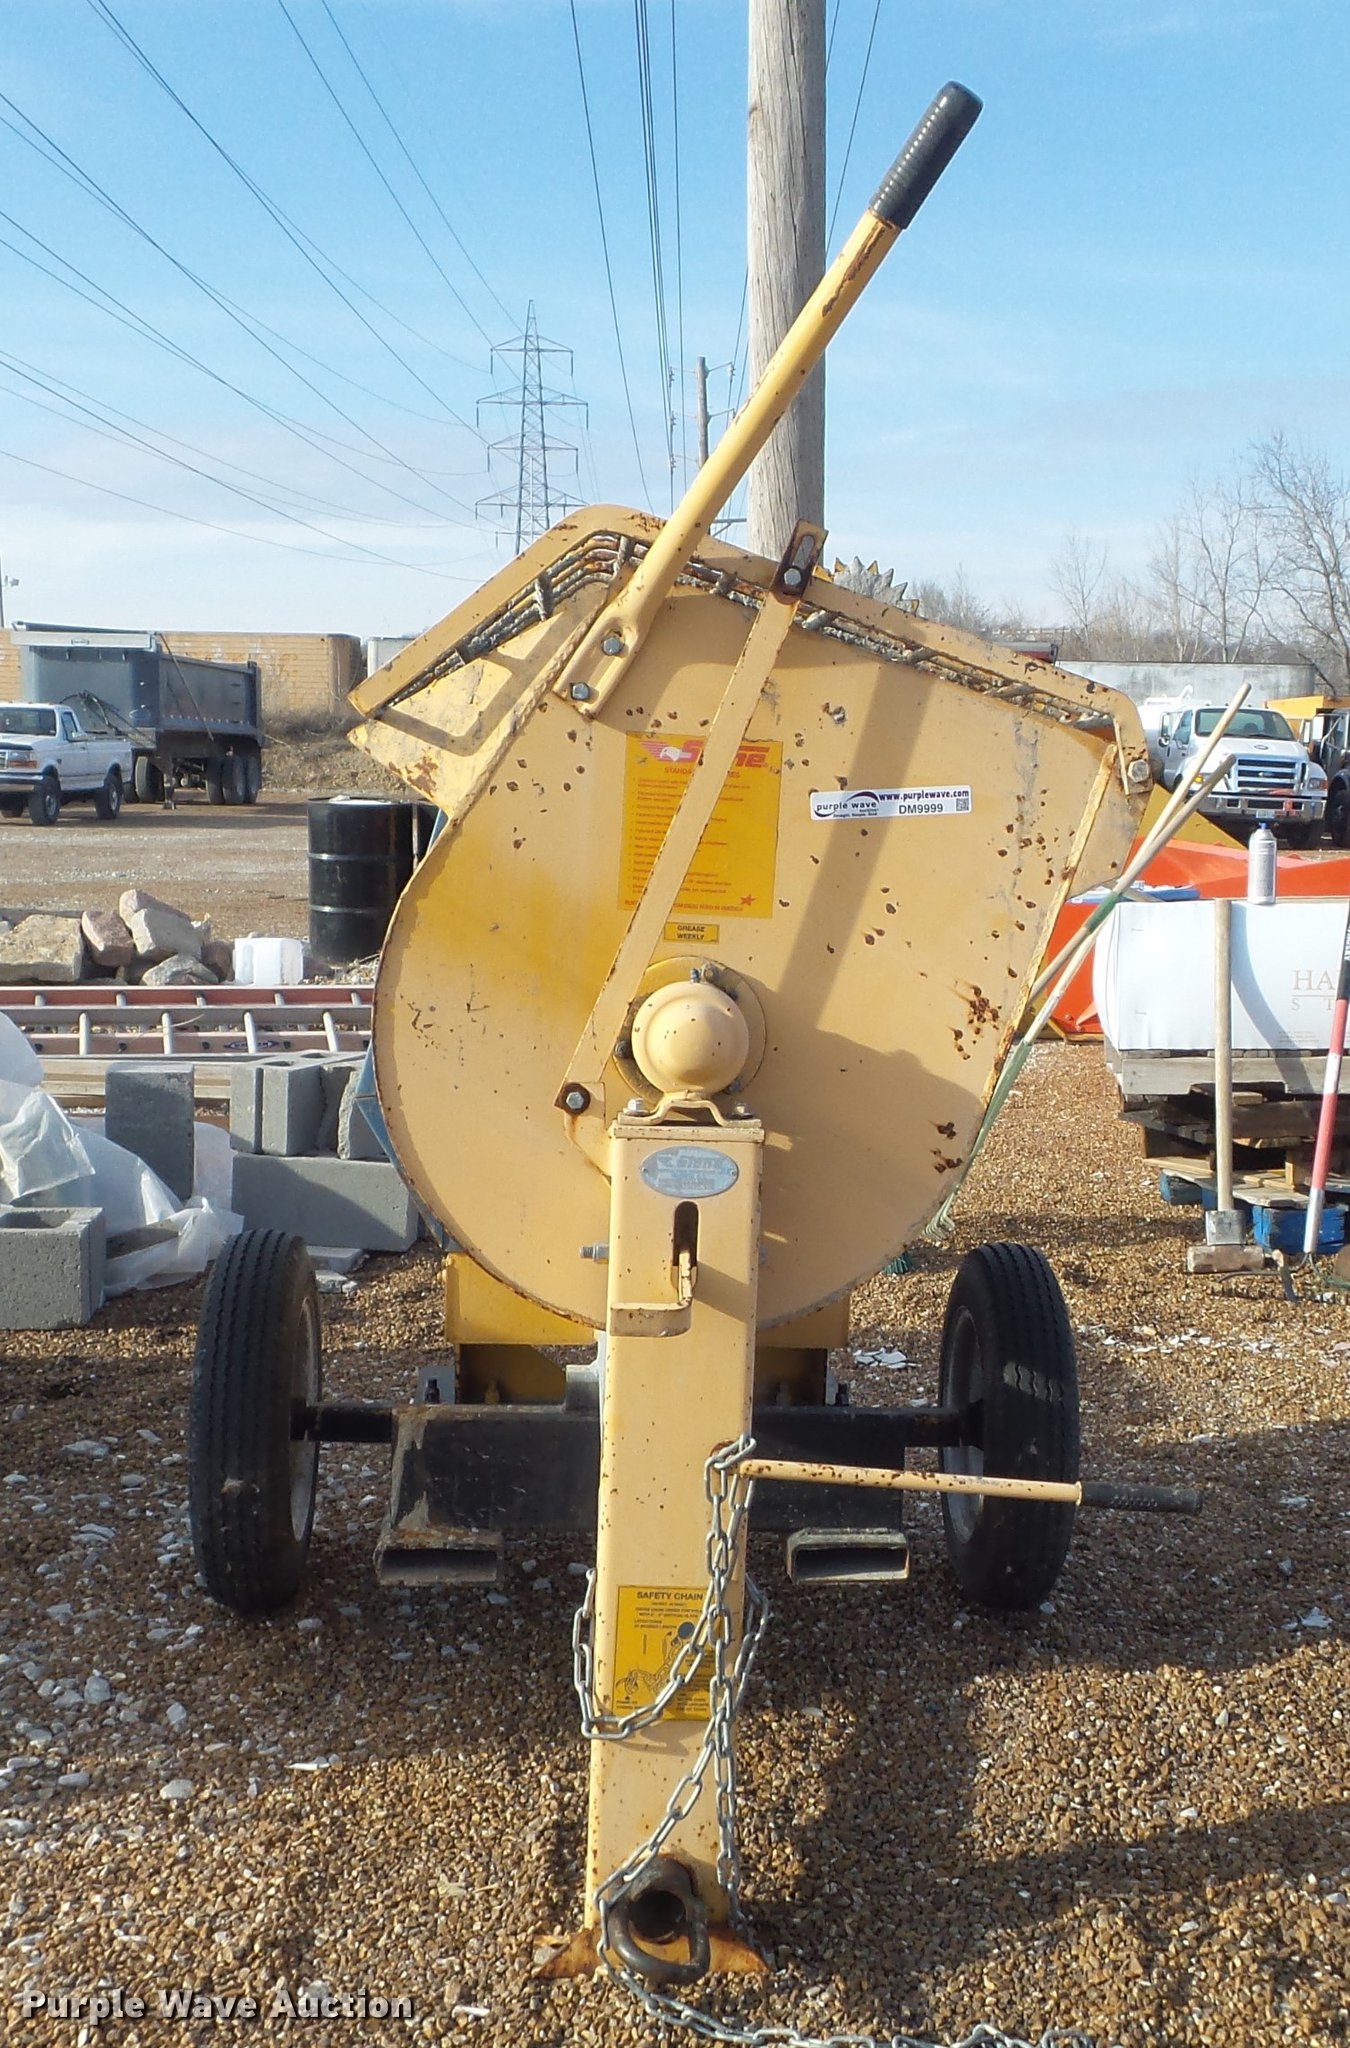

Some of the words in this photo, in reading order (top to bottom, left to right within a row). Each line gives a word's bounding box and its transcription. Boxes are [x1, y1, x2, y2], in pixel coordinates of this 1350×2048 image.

[879, 789, 969, 801] www.purplewave.com
[816, 802, 848, 811] purple
[852, 801, 877, 809] wave
[898, 803, 943, 815] DM9999
[637, 1591, 672, 1600] SAFETY
